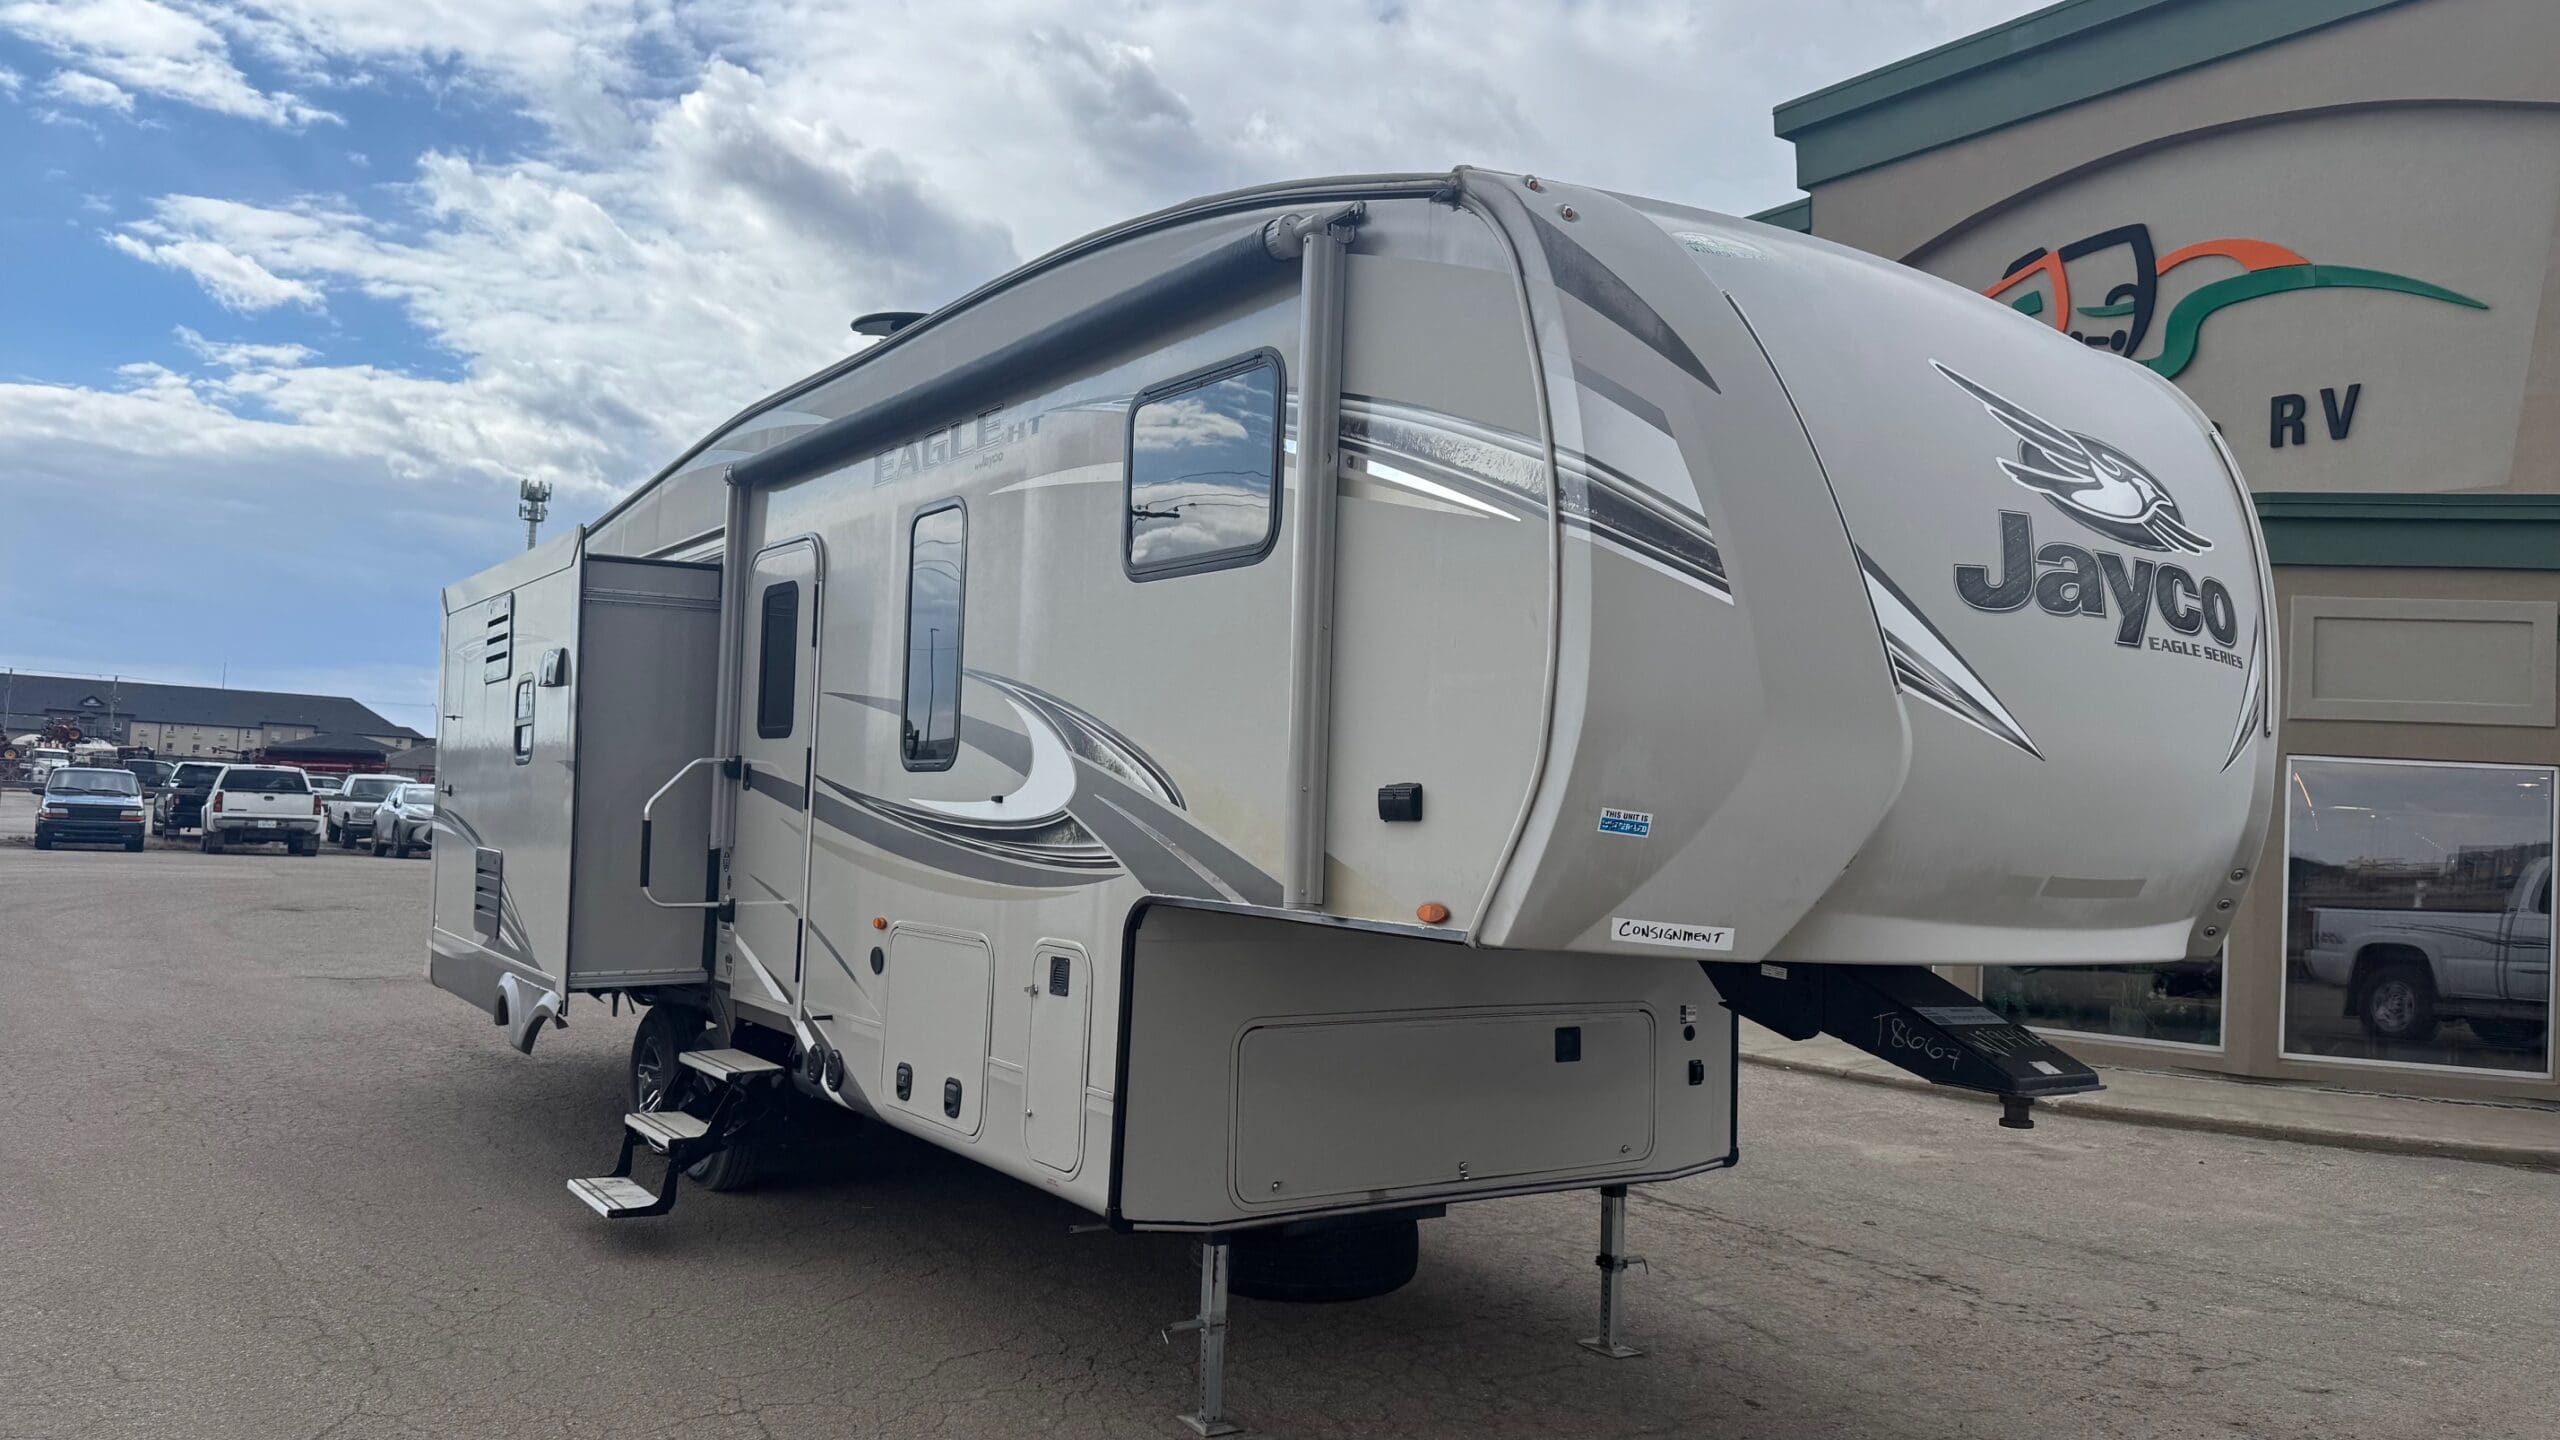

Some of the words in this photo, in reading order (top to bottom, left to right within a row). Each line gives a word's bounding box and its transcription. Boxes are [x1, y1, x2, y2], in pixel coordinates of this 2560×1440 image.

[873, 402, 1004, 488] EAGLE
[2270, 383, 2362, 449] RV
[1953, 508, 2239, 649] Jayco
[2149, 636, 2202, 659] EAGLE
[2204, 646, 2244, 670] SERIES
[1605, 810, 1622, 819] THIS
[1623, 812, 1641, 821] UNIT
[1618, 920, 1725, 944] CONSIGNMENT
[1873, 1011, 1962, 1071] T8667
